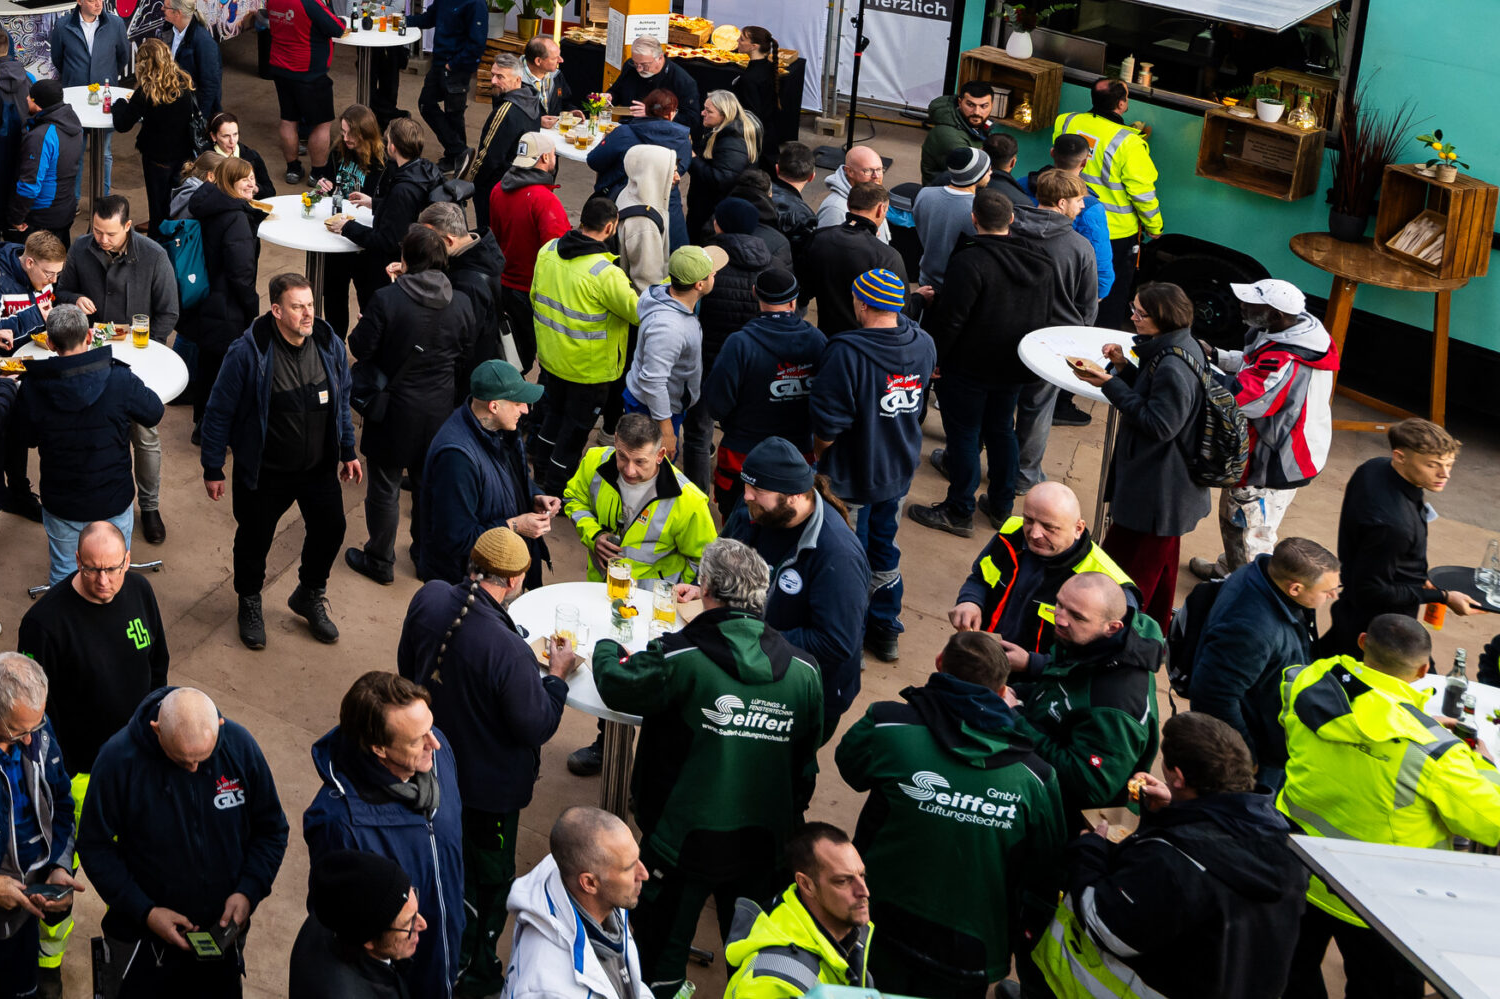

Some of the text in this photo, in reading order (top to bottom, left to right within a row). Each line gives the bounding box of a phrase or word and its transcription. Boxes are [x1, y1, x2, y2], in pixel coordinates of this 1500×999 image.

[880, 388, 922, 413] GAS
[701, 694, 794, 732] Seiffert
[214, 789, 245, 810] GAS
[898, 770, 1017, 819] Seiffert
[986, 787, 1021, 802] GmbH
[918, 801, 1013, 829] Lüftungstechnik
